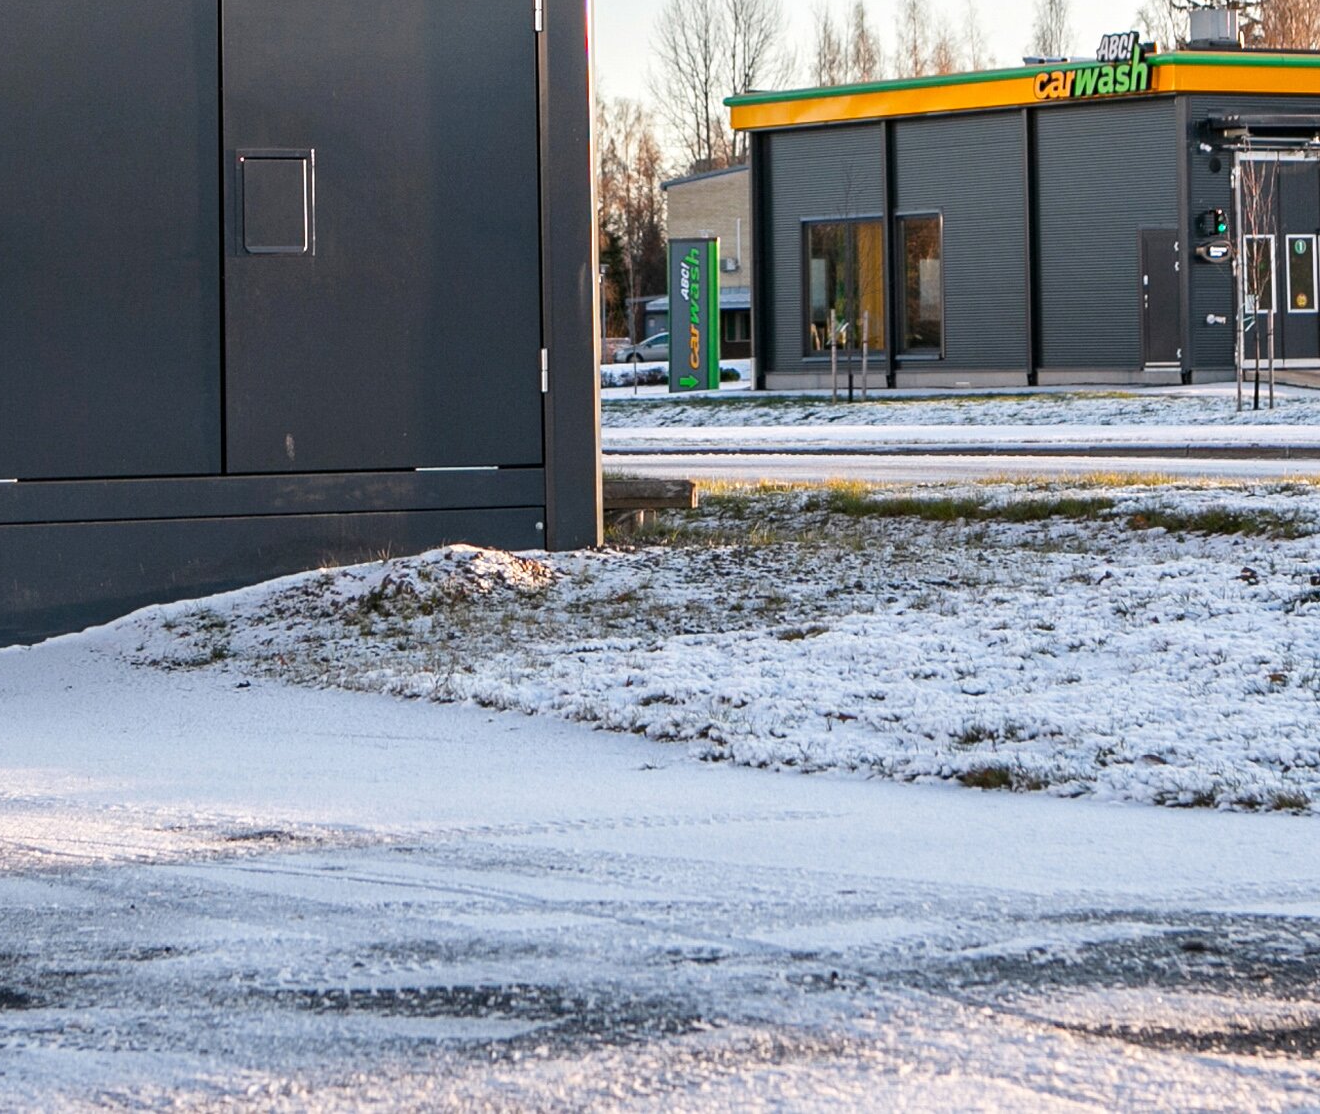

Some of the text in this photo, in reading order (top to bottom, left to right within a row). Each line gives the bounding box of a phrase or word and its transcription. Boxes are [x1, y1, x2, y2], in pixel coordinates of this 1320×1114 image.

[1098, 32, 1135, 61] ABC!
[1034, 43, 1148, 99] carwash
[680, 261, 690, 301] ABC!
[684, 248, 700, 370] carwash
